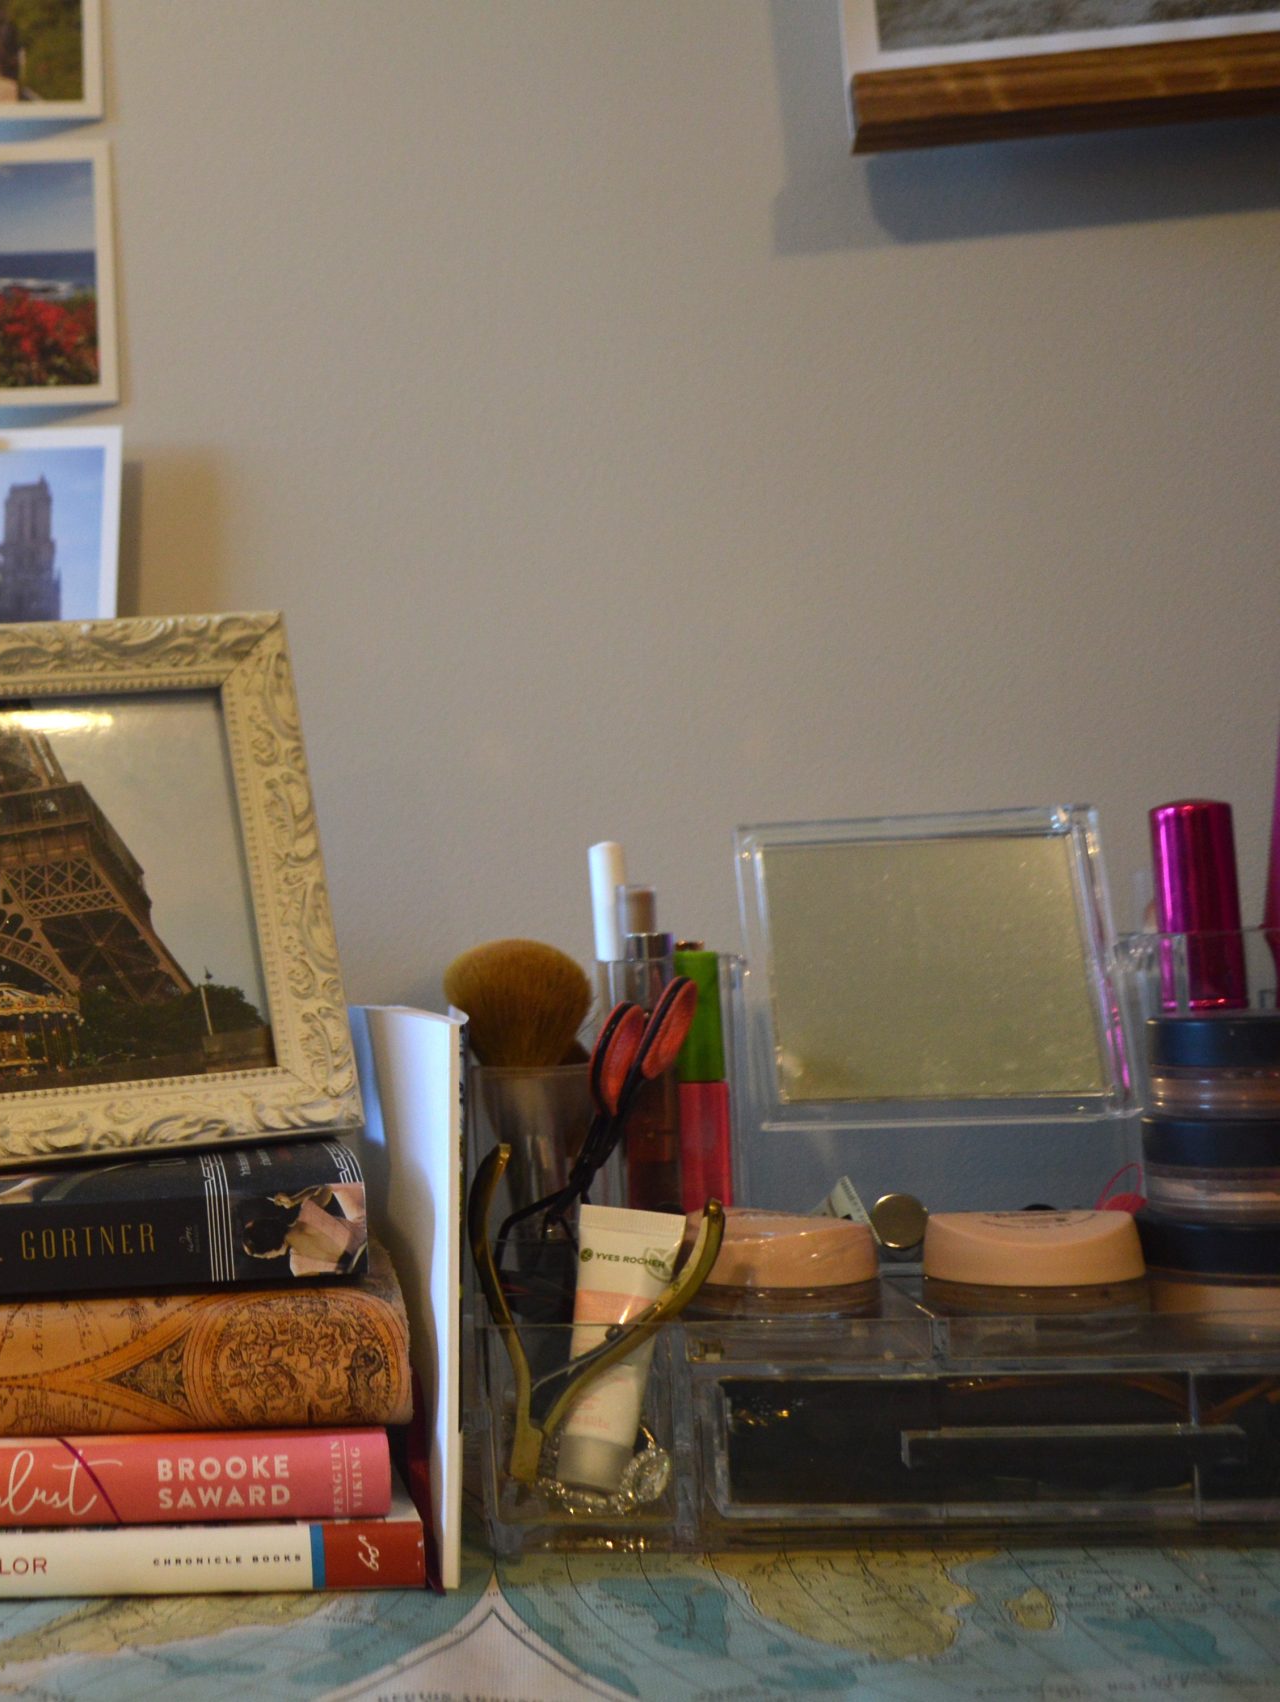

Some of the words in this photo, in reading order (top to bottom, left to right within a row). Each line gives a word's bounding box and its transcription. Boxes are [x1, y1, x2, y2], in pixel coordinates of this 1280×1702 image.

[21, 1222, 157, 1262] GORTNER
[596, 1253, 620, 1263] YVES
[623, 1255, 666, 1269] ROCHER
[157, 1454, 289, 1482] BROOKE
[330, 1440, 344, 1513] PENGUIN
[351, 1446, 363, 1508] VIKING
[158, 1485, 291, 1510] SAWARD
[152, 1554, 242, 1567] CHRONICLE
[251, 1553, 302, 1565] BOOKS
